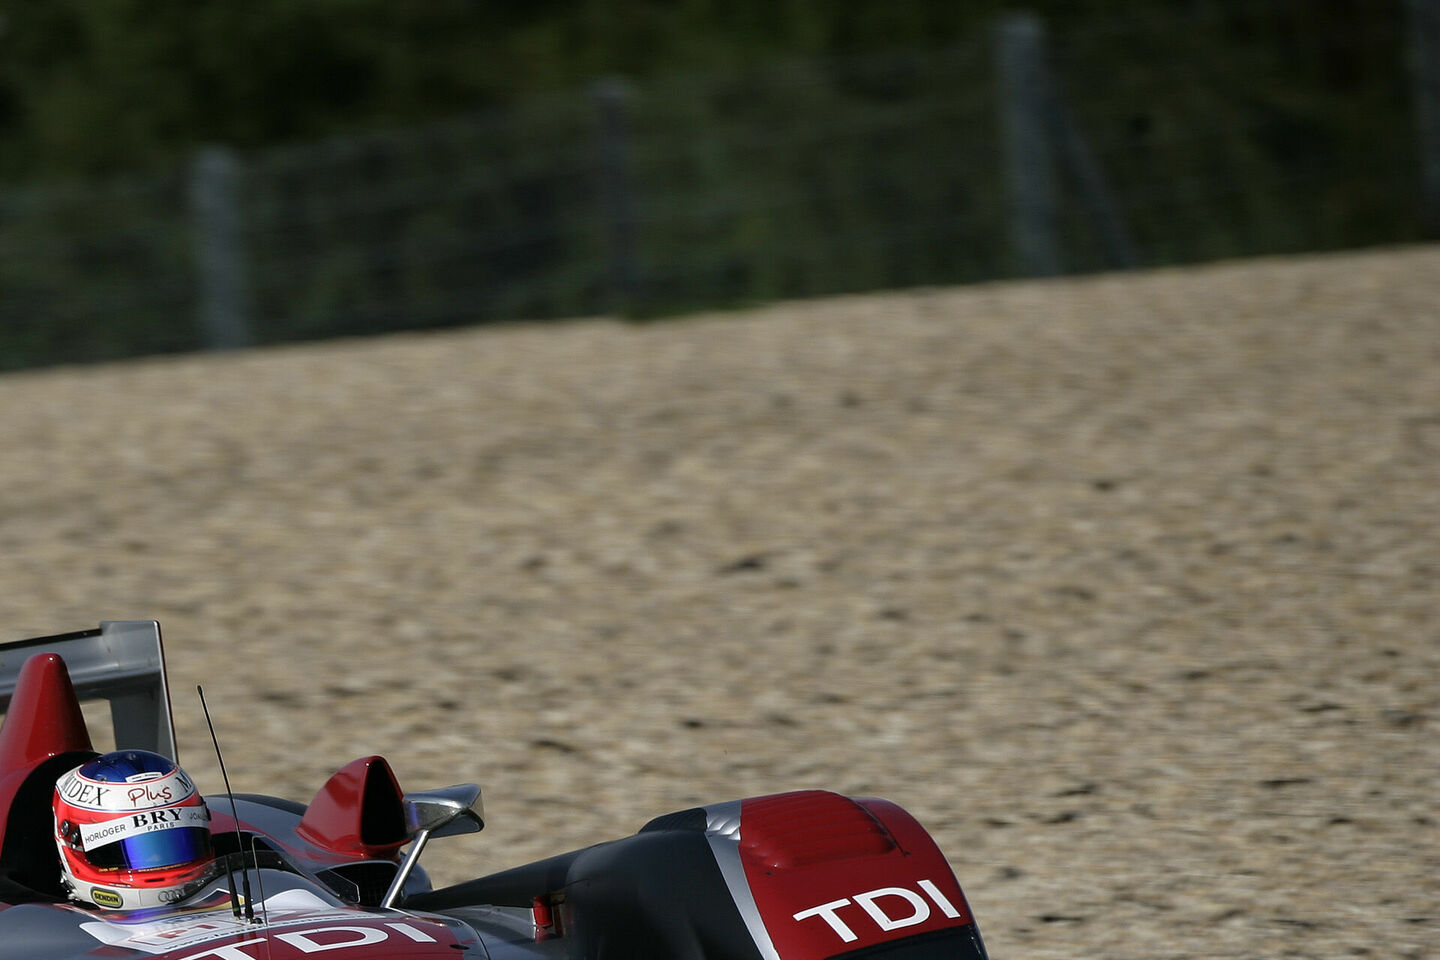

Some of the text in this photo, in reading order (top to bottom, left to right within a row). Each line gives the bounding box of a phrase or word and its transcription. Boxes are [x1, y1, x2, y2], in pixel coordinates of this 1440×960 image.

[128, 785, 172, 807] Plus
[131, 808, 183, 828] BRY
[147, 822, 175, 832] PARIS
[85, 824, 127, 844] HORLOGER
[792, 879, 961, 943] TDI
